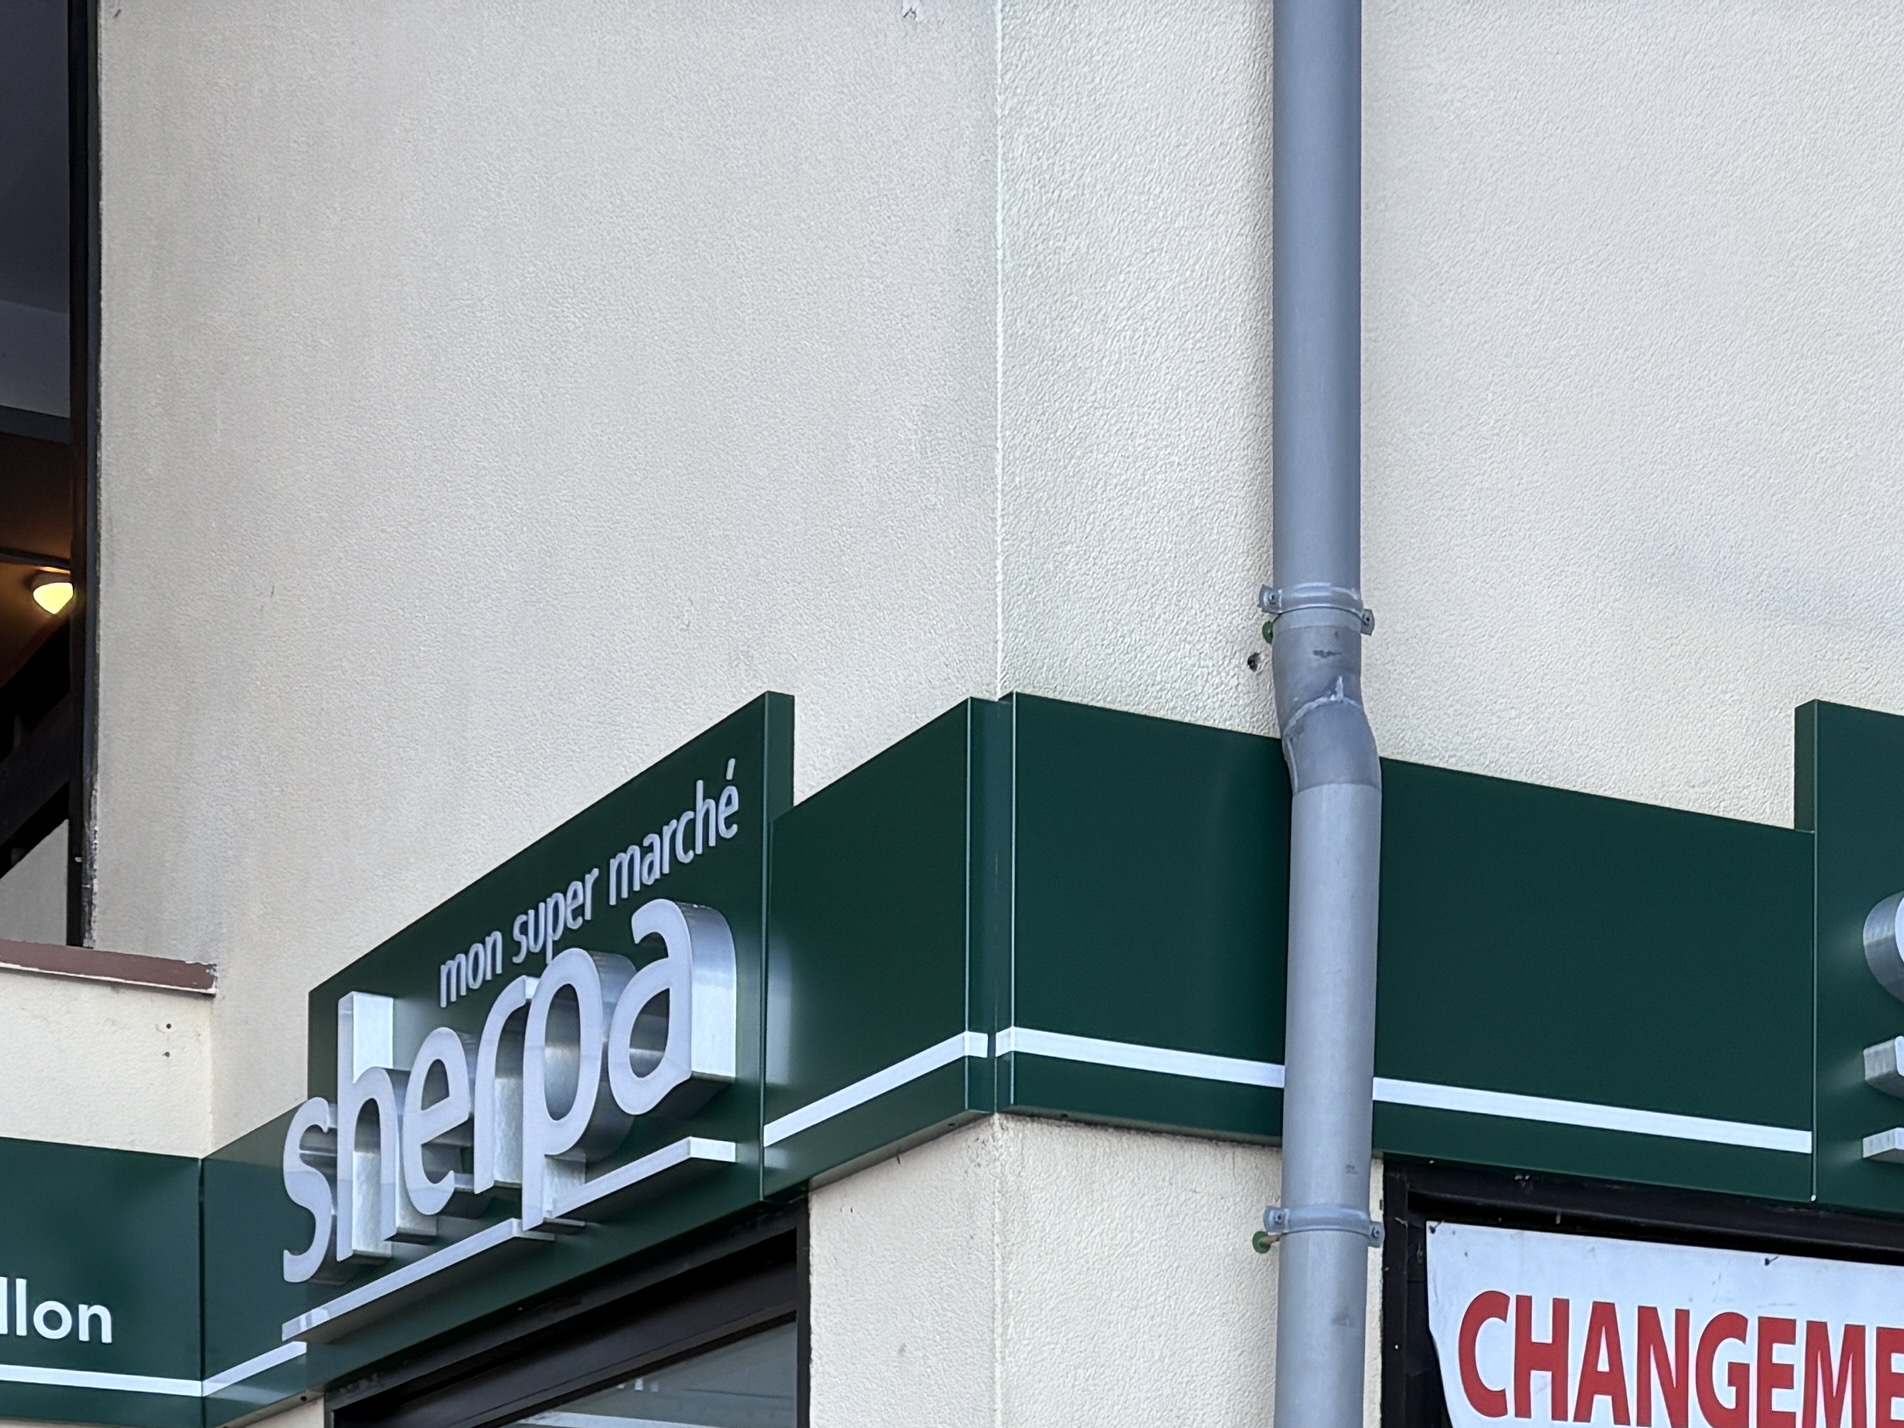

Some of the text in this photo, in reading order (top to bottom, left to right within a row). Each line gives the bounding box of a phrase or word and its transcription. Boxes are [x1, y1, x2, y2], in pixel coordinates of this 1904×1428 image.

[439, 758, 739, 1008] mon super marché
[282, 898, 721, 1283] sherpa
